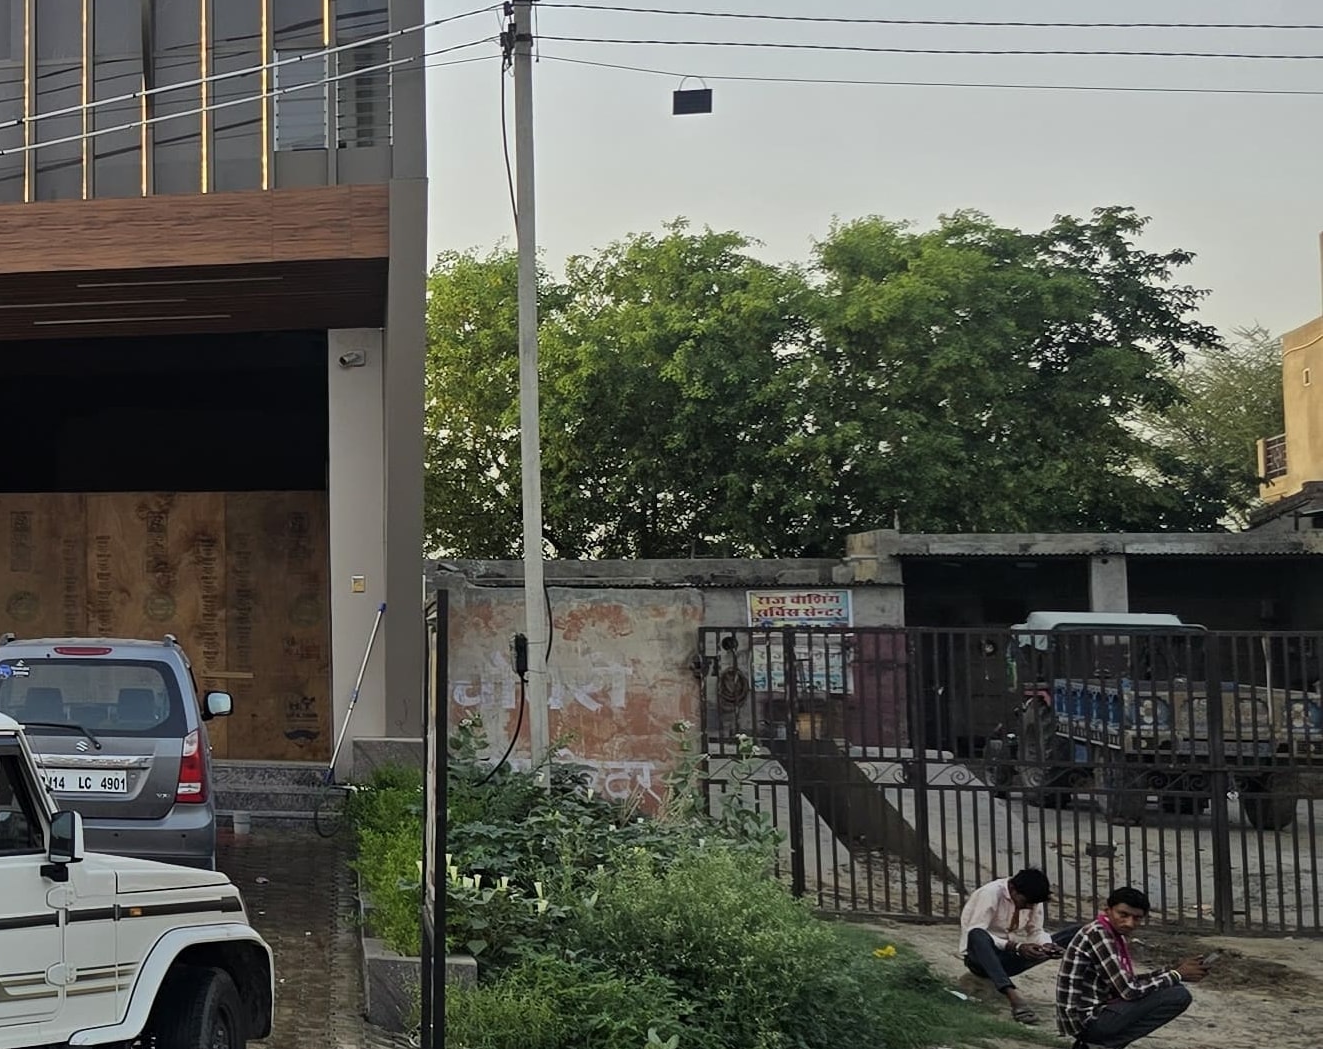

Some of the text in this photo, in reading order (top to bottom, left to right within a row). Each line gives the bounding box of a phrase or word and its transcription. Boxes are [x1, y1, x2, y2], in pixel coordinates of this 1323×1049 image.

[756, 596, 786, 605] राज
[78, 776, 92, 790] LC
[100, 777, 126, 790] 4901
